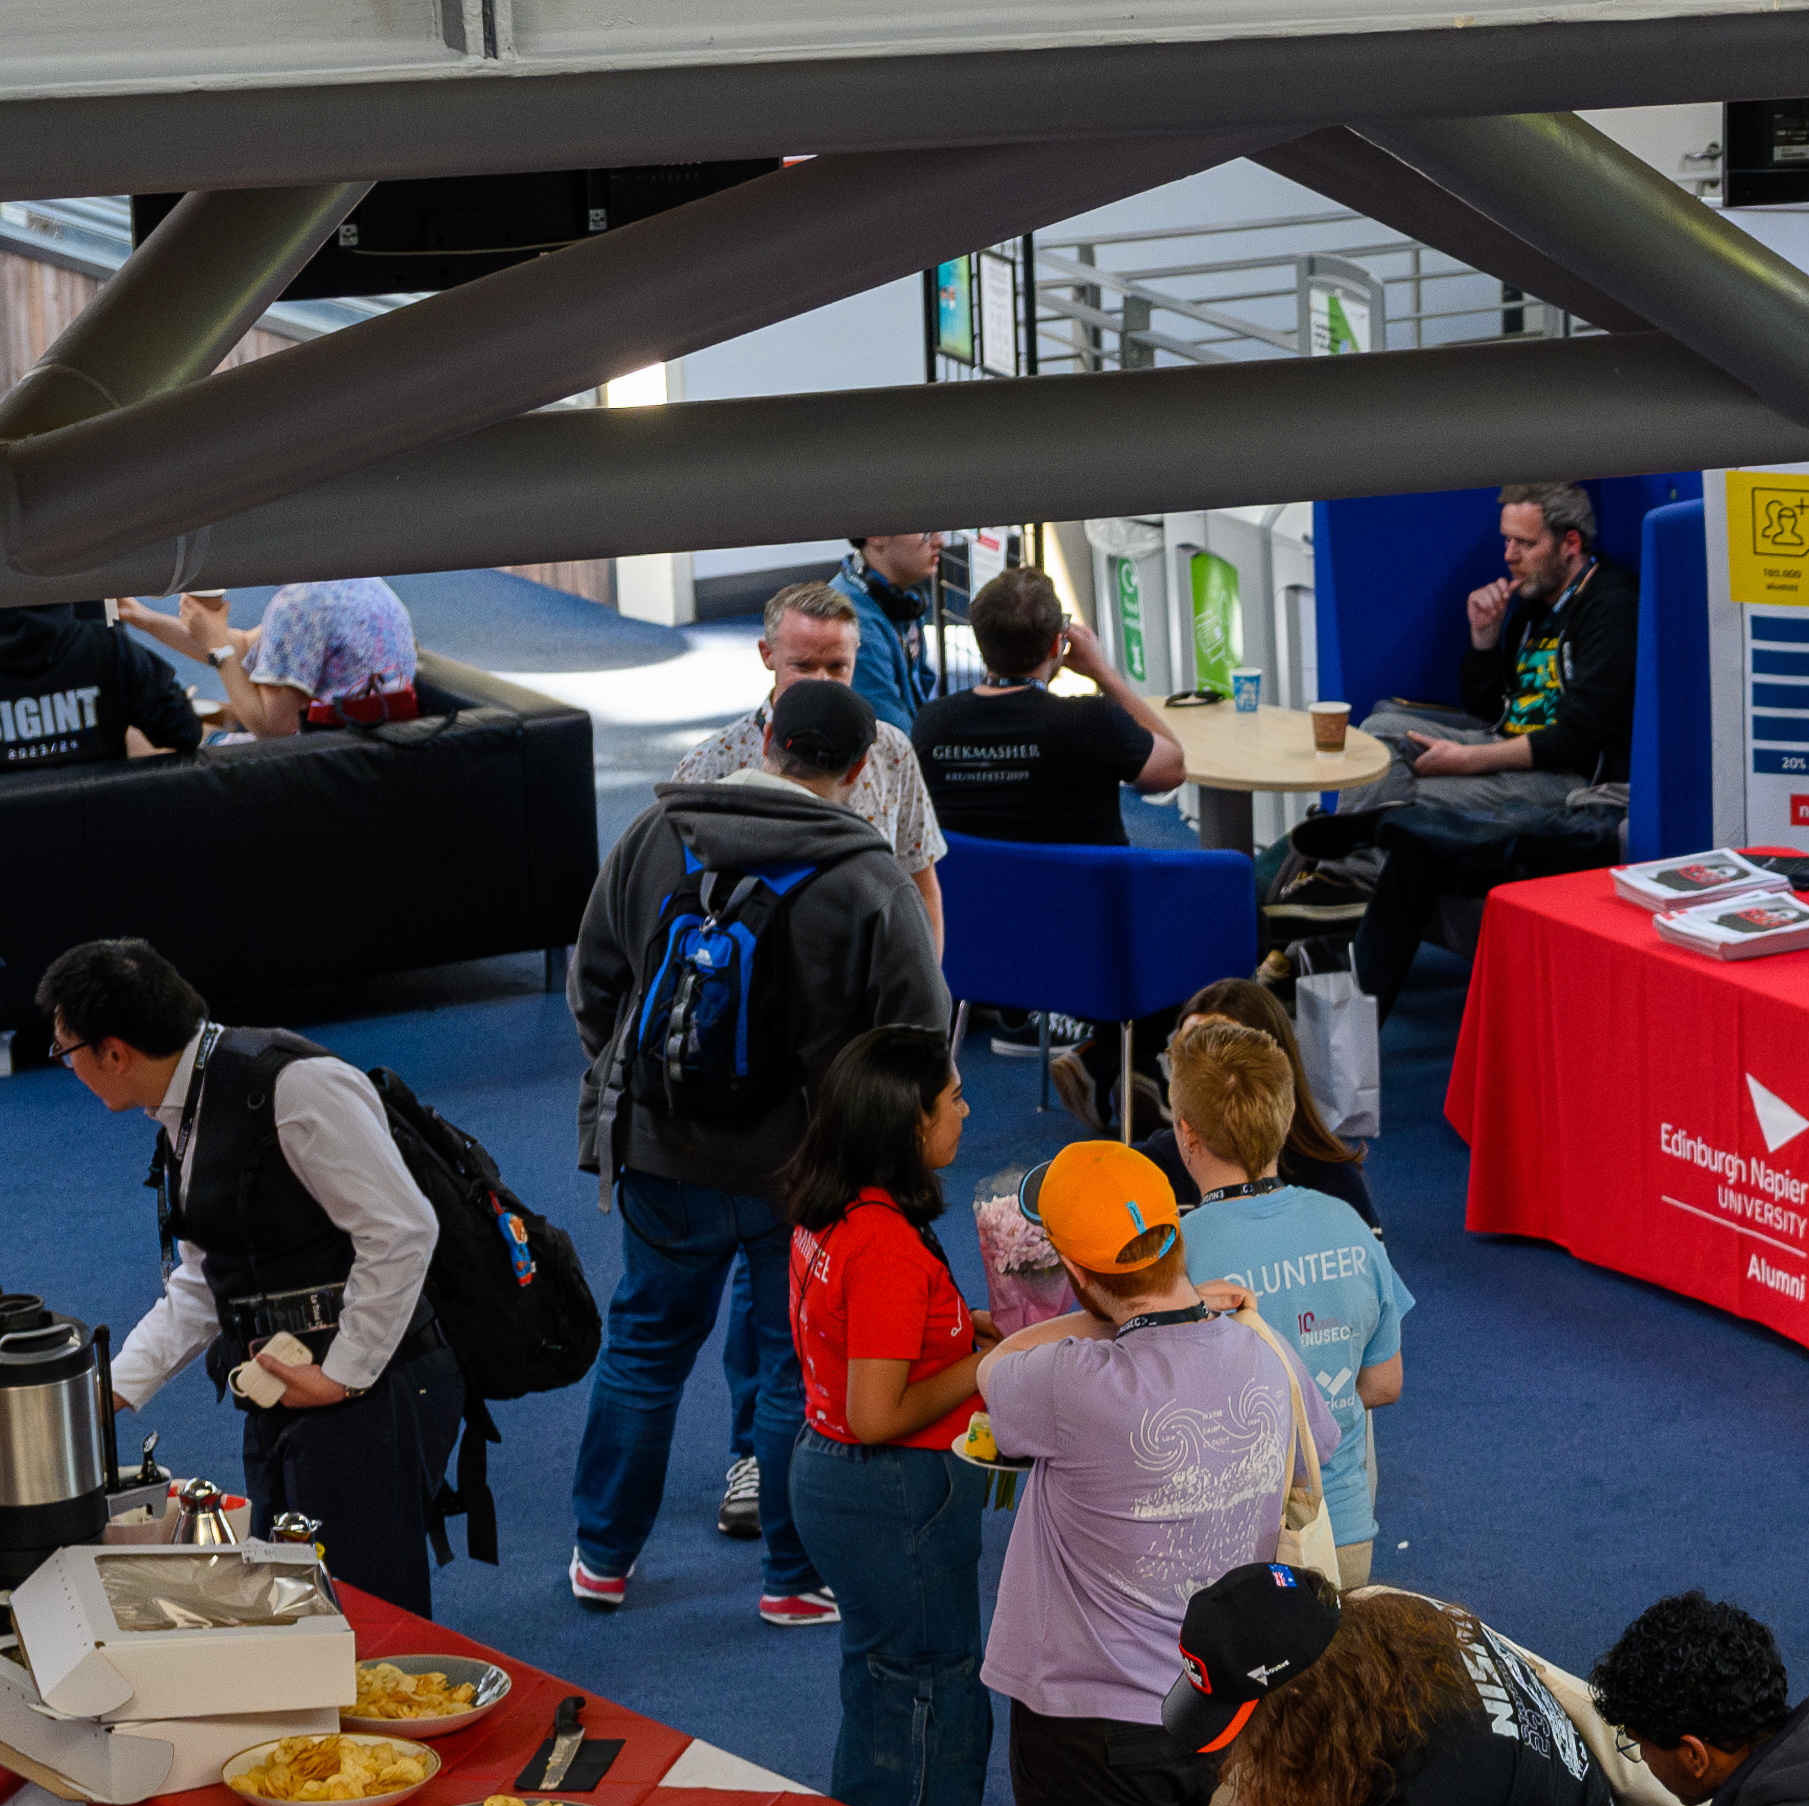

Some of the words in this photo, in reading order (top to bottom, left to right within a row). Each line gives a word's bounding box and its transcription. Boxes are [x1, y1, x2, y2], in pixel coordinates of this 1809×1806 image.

[0, 685, 100, 742] IGINT
[1782, 757, 1806, 770] 20%
[1661, 1122, 1747, 1185] Edinburgh
[1751, 1157, 1809, 1205] Napier
[1718, 1185, 1807, 1239] UNIVERSITY
[1223, 1246, 1367, 1298] OLUNTEER
[1747, 1254, 1806, 1302] Alumni
